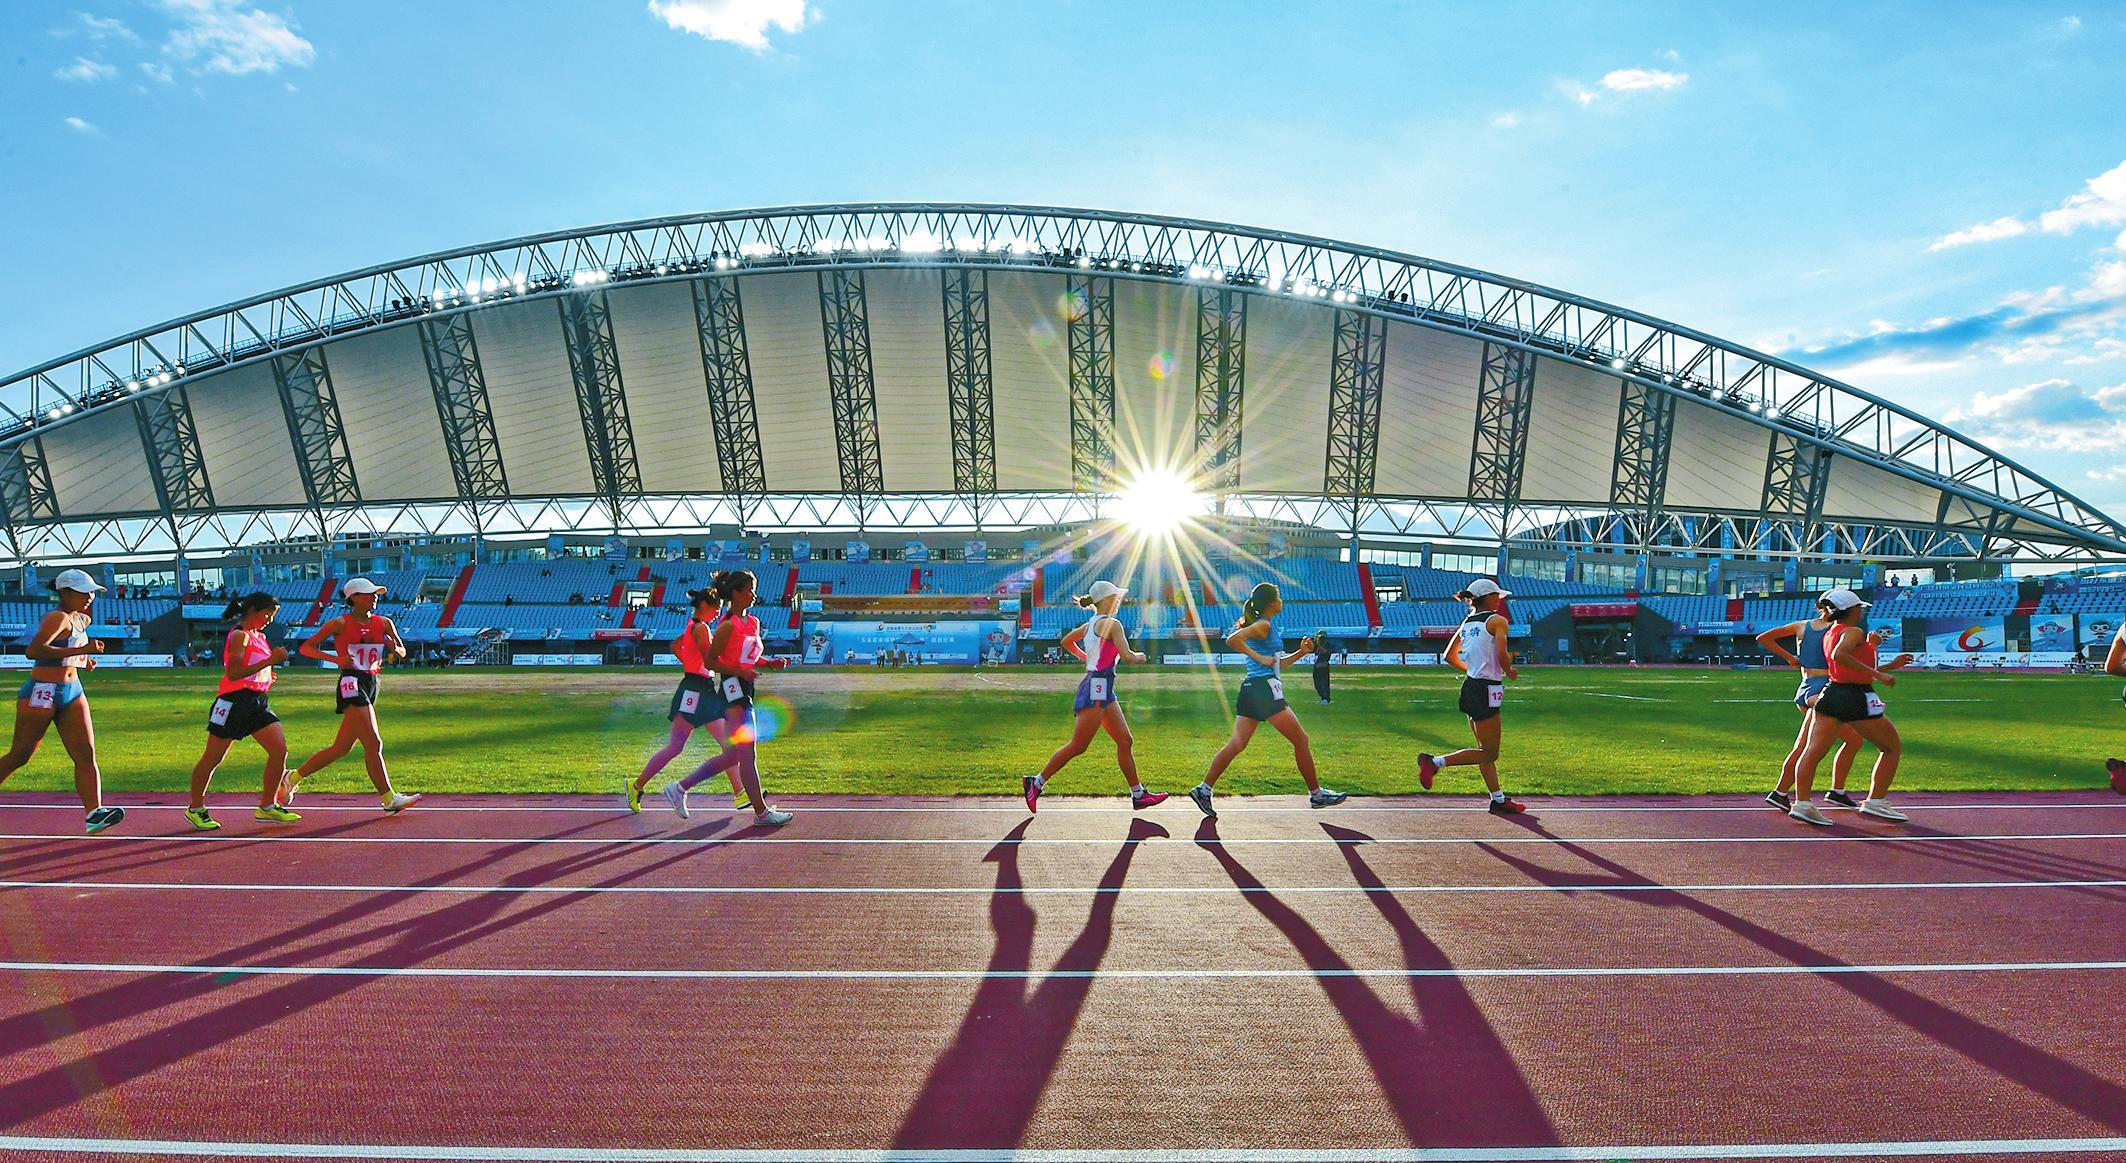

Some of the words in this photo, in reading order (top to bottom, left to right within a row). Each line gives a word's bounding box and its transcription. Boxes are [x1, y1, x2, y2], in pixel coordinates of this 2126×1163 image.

[357, 647, 377, 666] 16
[343, 682, 355, 692] 16
[728, 684, 737, 694] 2
[1095, 684, 1103, 693] 3
[36, 690, 52, 701] 13
[1492, 691, 1503, 701] 12
[686, 697, 693, 706] 9
[214, 706, 226, 718] 14
